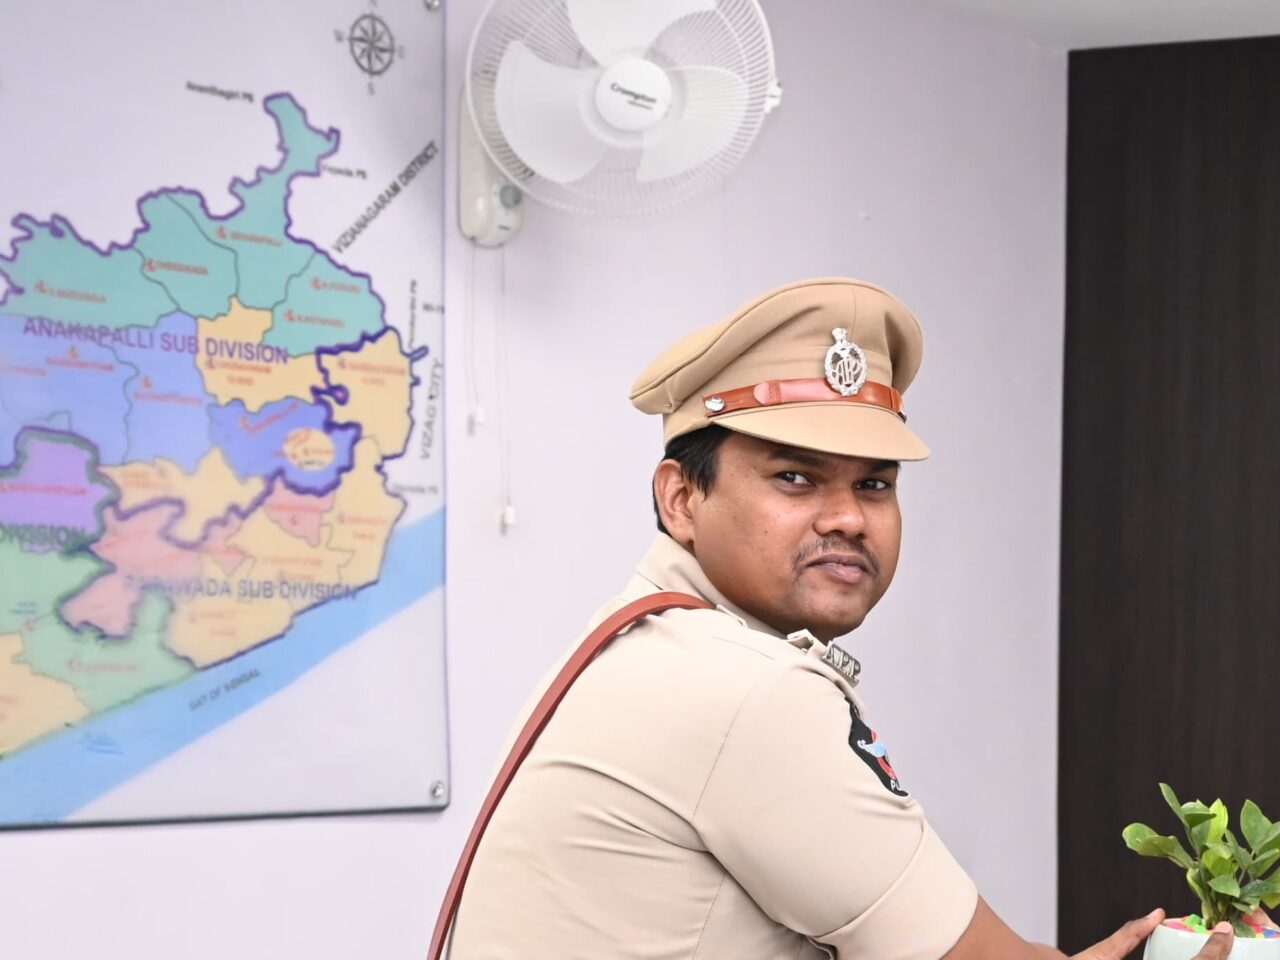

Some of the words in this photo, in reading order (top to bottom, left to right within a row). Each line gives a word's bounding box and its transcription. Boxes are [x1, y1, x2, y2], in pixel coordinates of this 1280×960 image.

[397, 140, 439, 187] DISTRICT
[23, 316, 154, 349] ANAKAPALLI
[160, 332, 199, 355] SUB
[205, 337, 289, 365] DIVISION
[237, 579, 274, 599] SUB
[279, 580, 358, 600] DIVISION
